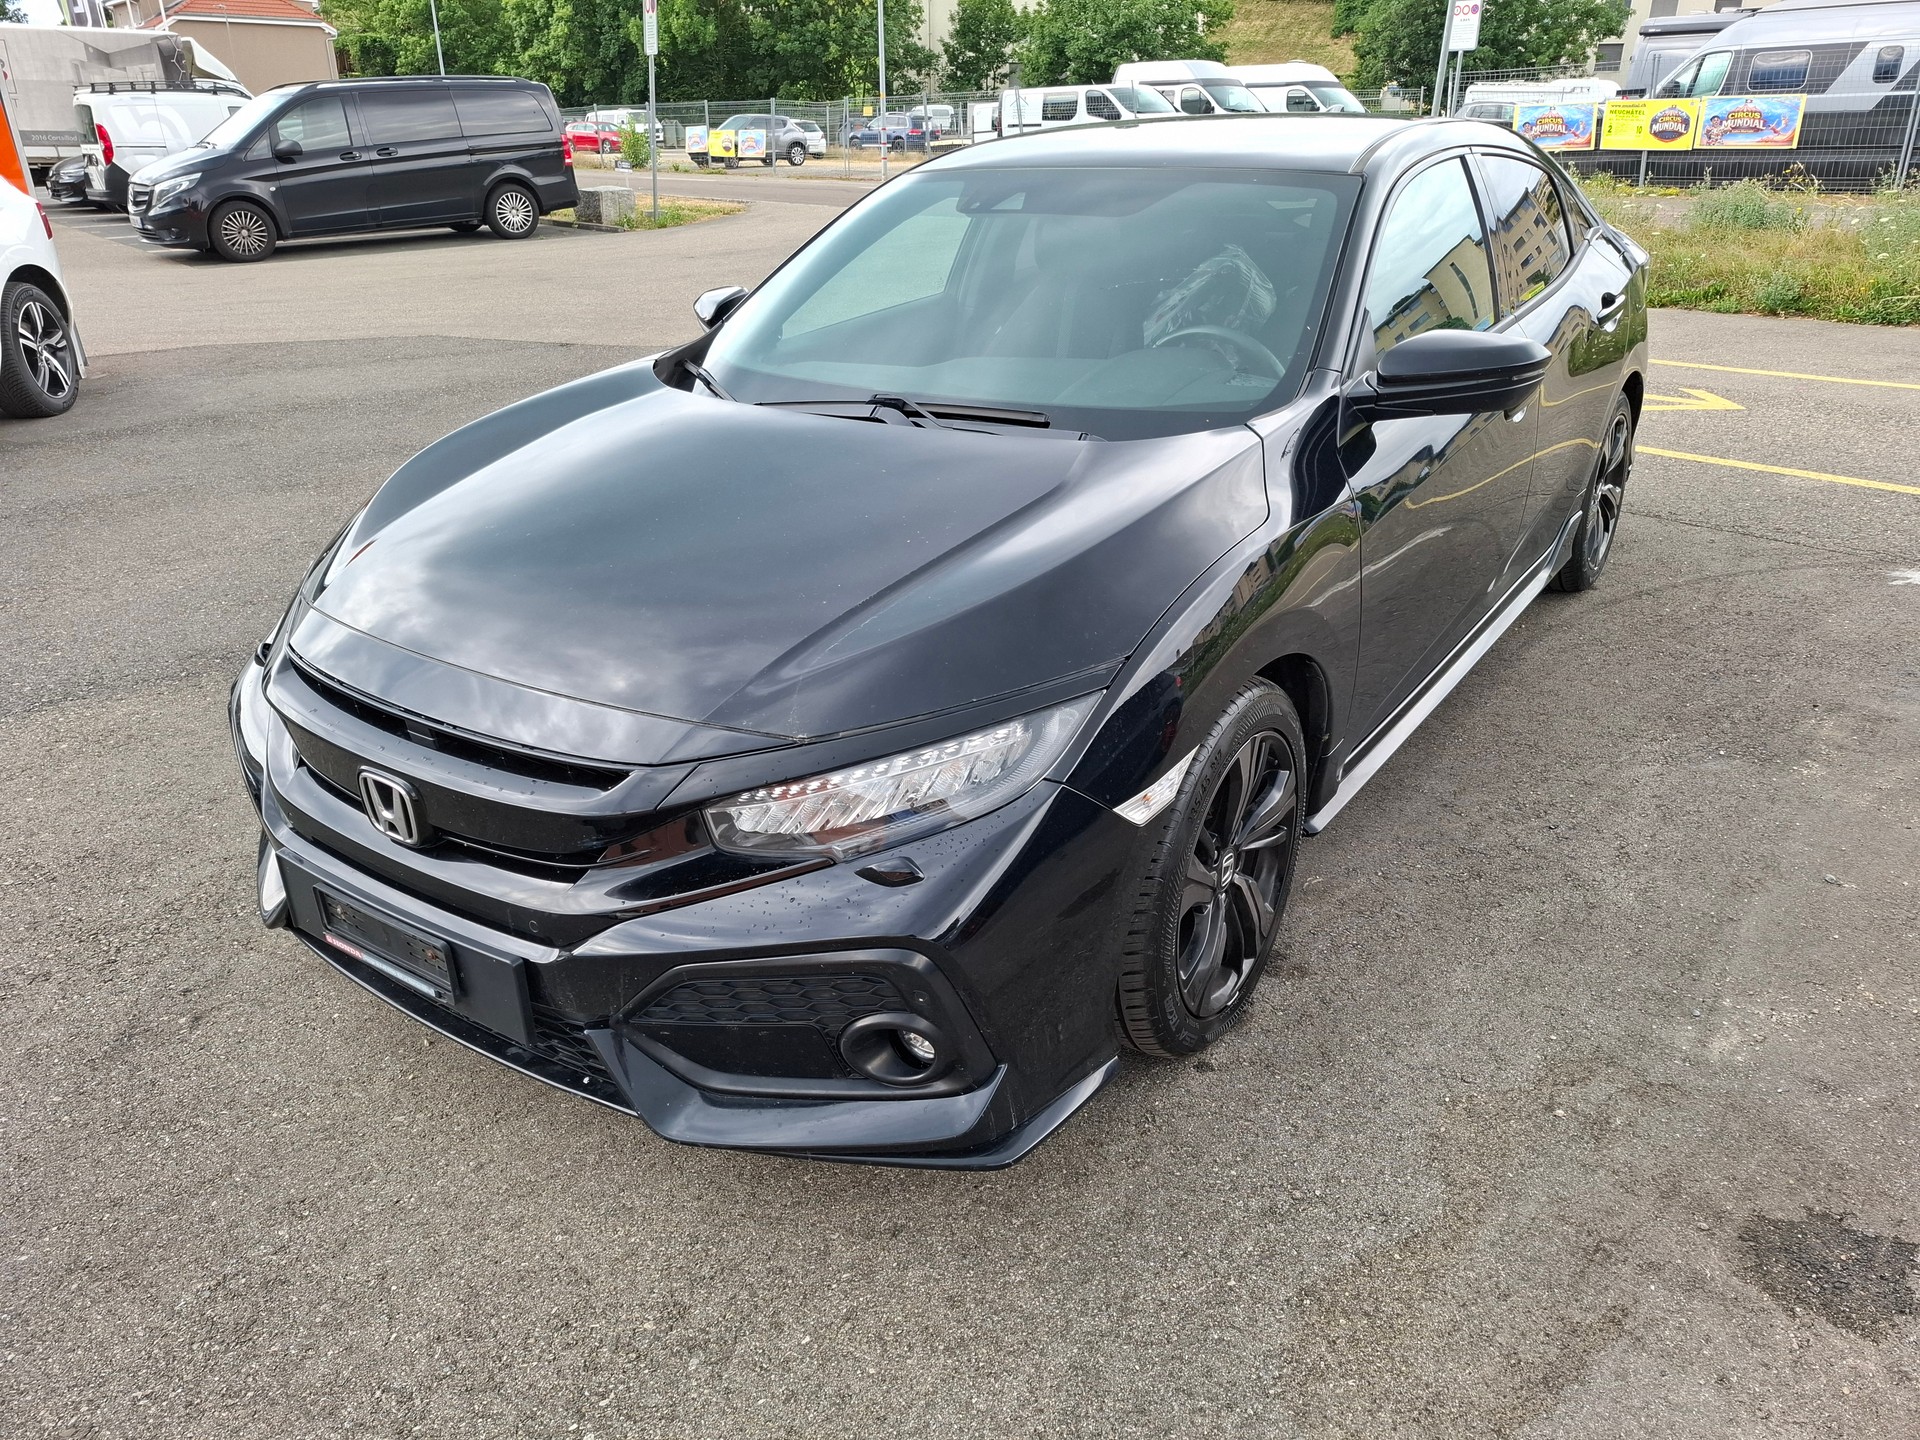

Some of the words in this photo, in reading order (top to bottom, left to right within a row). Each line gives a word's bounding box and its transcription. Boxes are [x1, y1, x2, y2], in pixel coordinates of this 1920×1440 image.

[1728, 111, 1761, 119] CIRCUS
[1536, 117, 1563, 125] CIRCUS
[1721, 119, 1767, 130] MUNDIAL
[1531, 124, 1568, 134] MUNDIAL
[1651, 122, 1687, 134] MUNDIAL
[332, 940, 362, 959] HONDA
